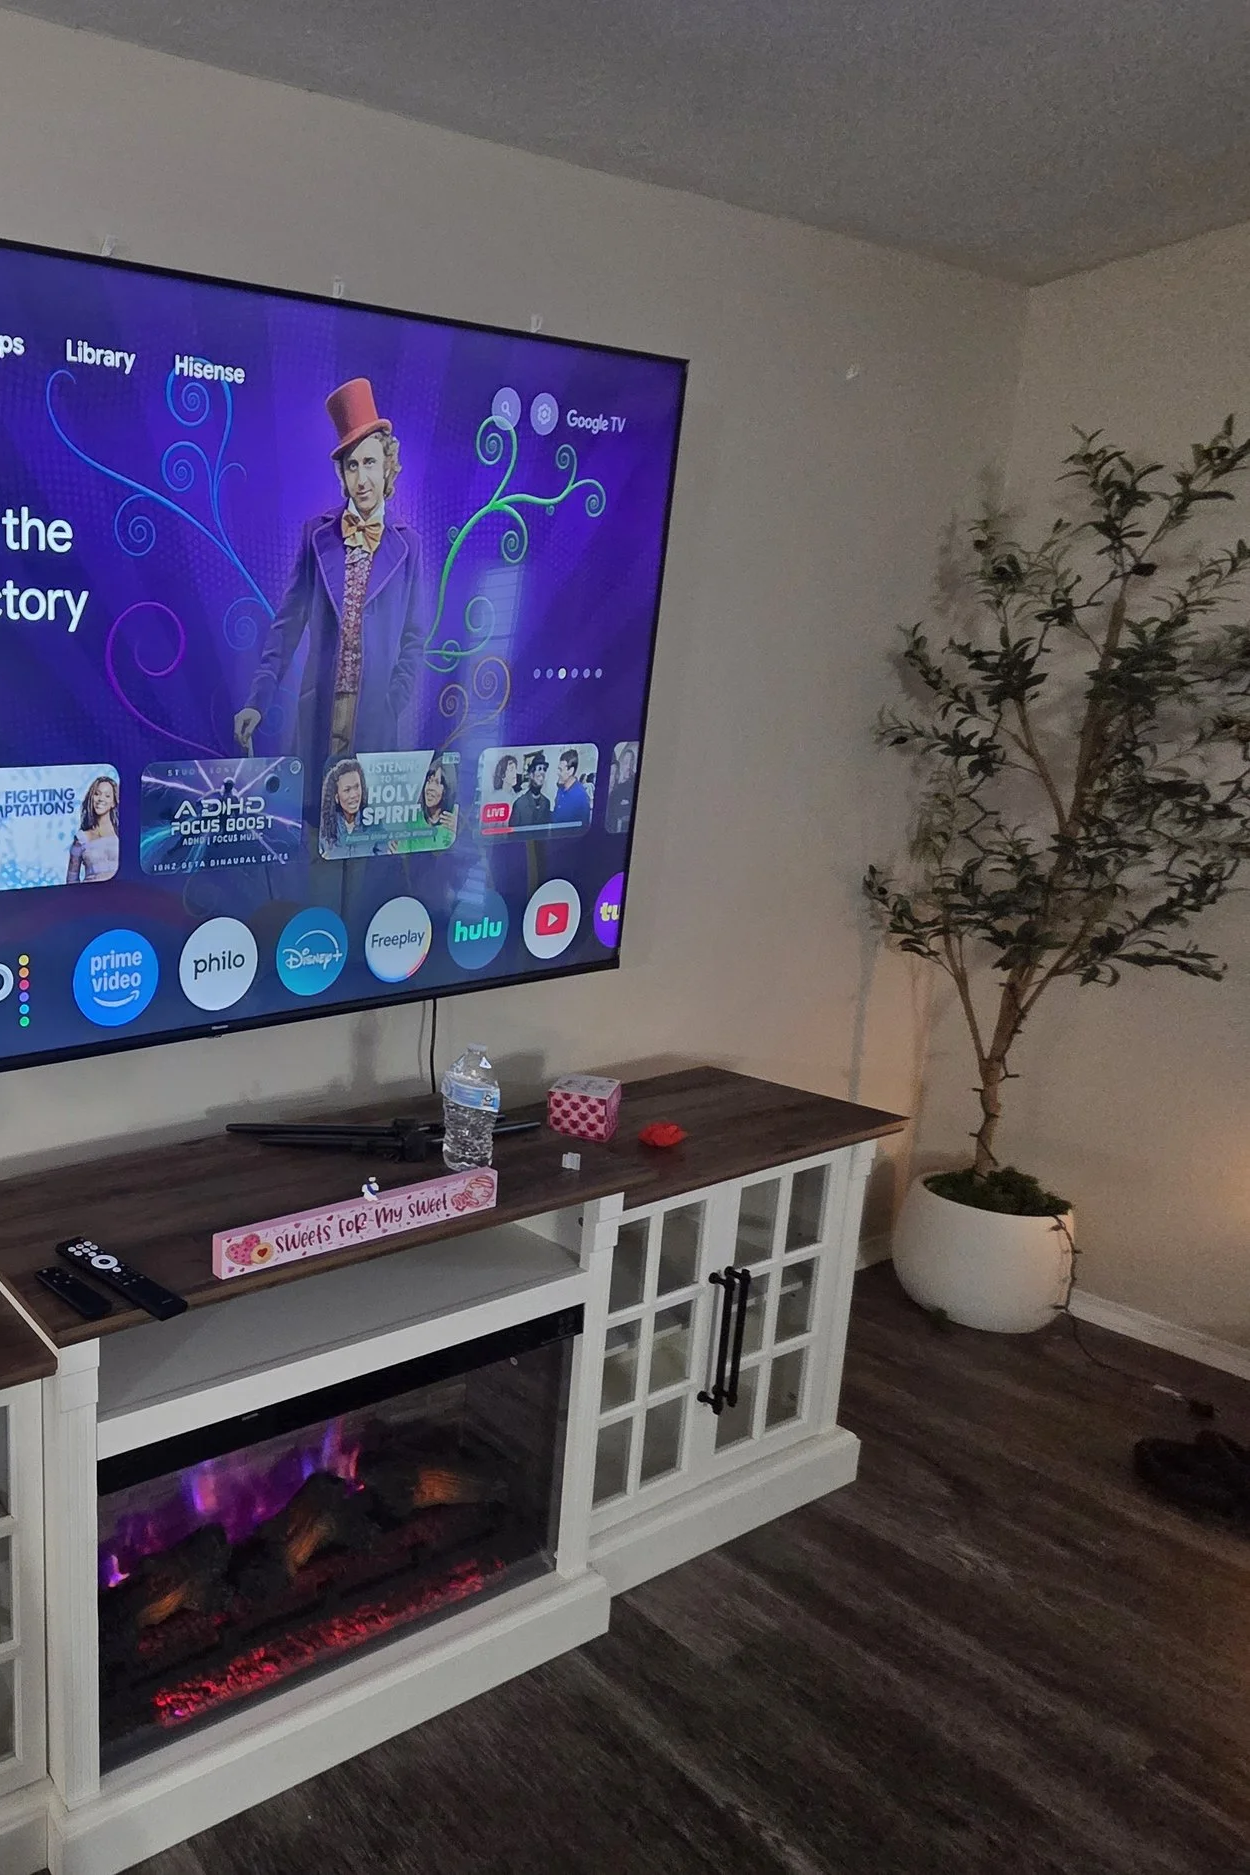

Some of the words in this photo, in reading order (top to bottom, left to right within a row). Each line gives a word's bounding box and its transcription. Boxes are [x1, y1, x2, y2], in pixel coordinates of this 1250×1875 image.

[64, 338, 137, 375] Library
[173, 354, 246, 385] Hisense
[566, 409, 609, 435] Google
[610, 416, 627, 433] TV
[1, 506, 73, 553] the
[5, 788, 76, 804] FIGHTING
[367, 783, 418, 804] HOLY
[174, 796, 266, 819] ADHD
[362, 804, 421, 826] SPIRIT
[486, 807, 505, 818] LIVE
[170, 819, 220, 836] FOCUS
[226, 816, 274, 832] BOOST
[212, 834, 238, 844] FOCUS
[371, 929, 426, 949] Freeplay
[454, 916, 502, 943] hulu
[90, 950, 142, 976] prime
[193, 950, 245, 980] philo
[91, 971, 142, 993] video
